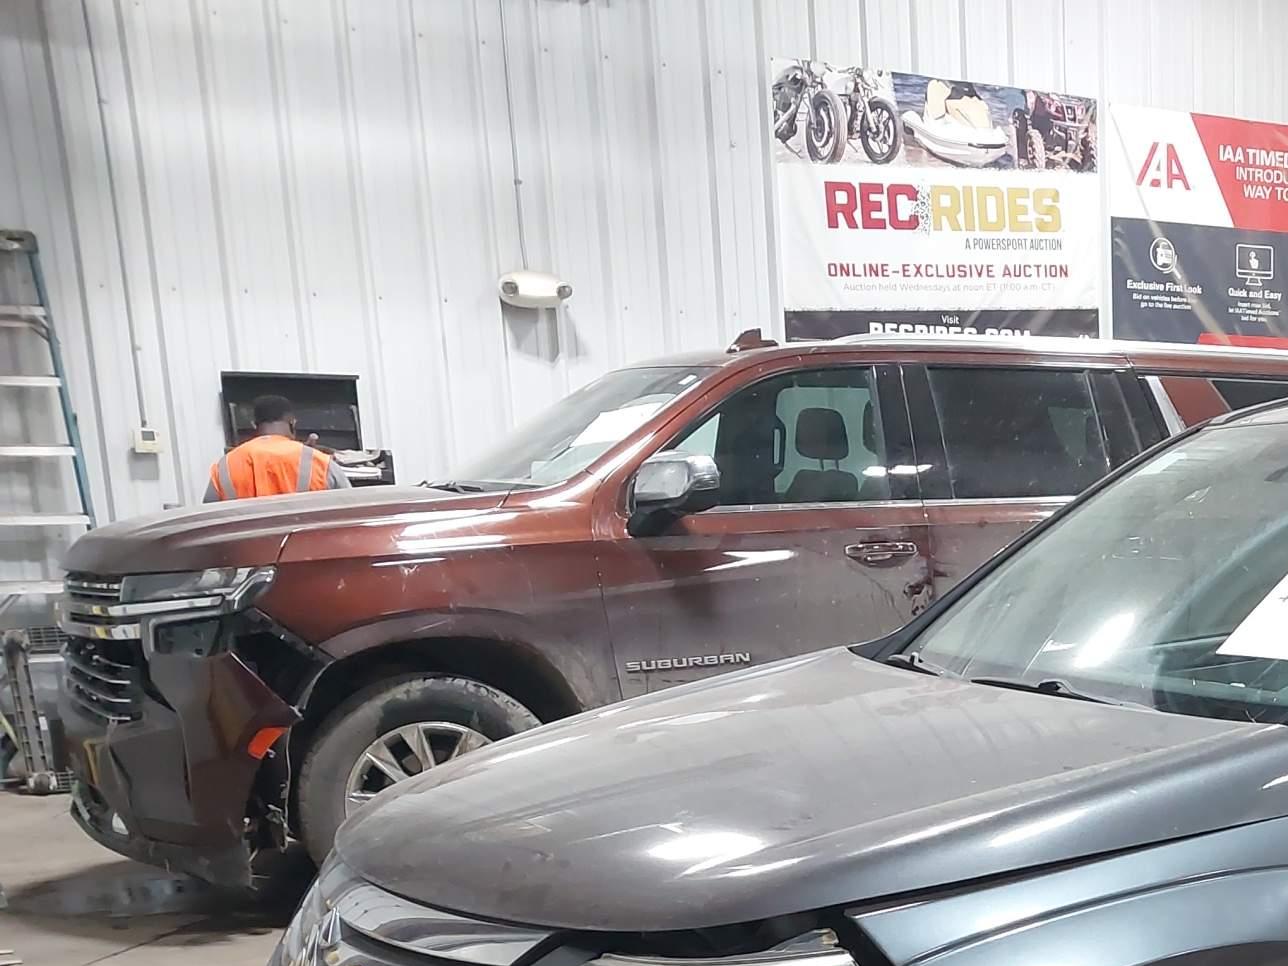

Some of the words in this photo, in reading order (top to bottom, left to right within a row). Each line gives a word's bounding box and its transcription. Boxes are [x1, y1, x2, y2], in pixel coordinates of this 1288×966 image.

[1219, 144, 1244, 163] IAA
[1243, 183, 1274, 200] WAY
[824, 180, 919, 229] REC
[929, 185, 1062, 232] RIDES
[965, 237, 971, 250] A
[973, 238, 1028, 251] POWERSPORT
[1029, 238, 1062, 251] AUCTION
[827, 262, 996, 279] ONLINE-EXCLUSIVE
[1002, 263, 1069, 279] AUCTION
[843, 282, 878, 291] Auction
[1126, 279, 1165, 292] Exclusive
[1165, 282, 1184, 293] First
[1184, 284, 1202, 295] Look
[1228, 287, 1248, 298] Quick
[1248, 289, 1263, 299] and
[1264, 289, 1282, 301] Easy
[941, 314, 960, 326] Visit
[869, 321, 1031, 337] RECRIDESCOM
[626, 652, 751, 672] SUBURBAN
